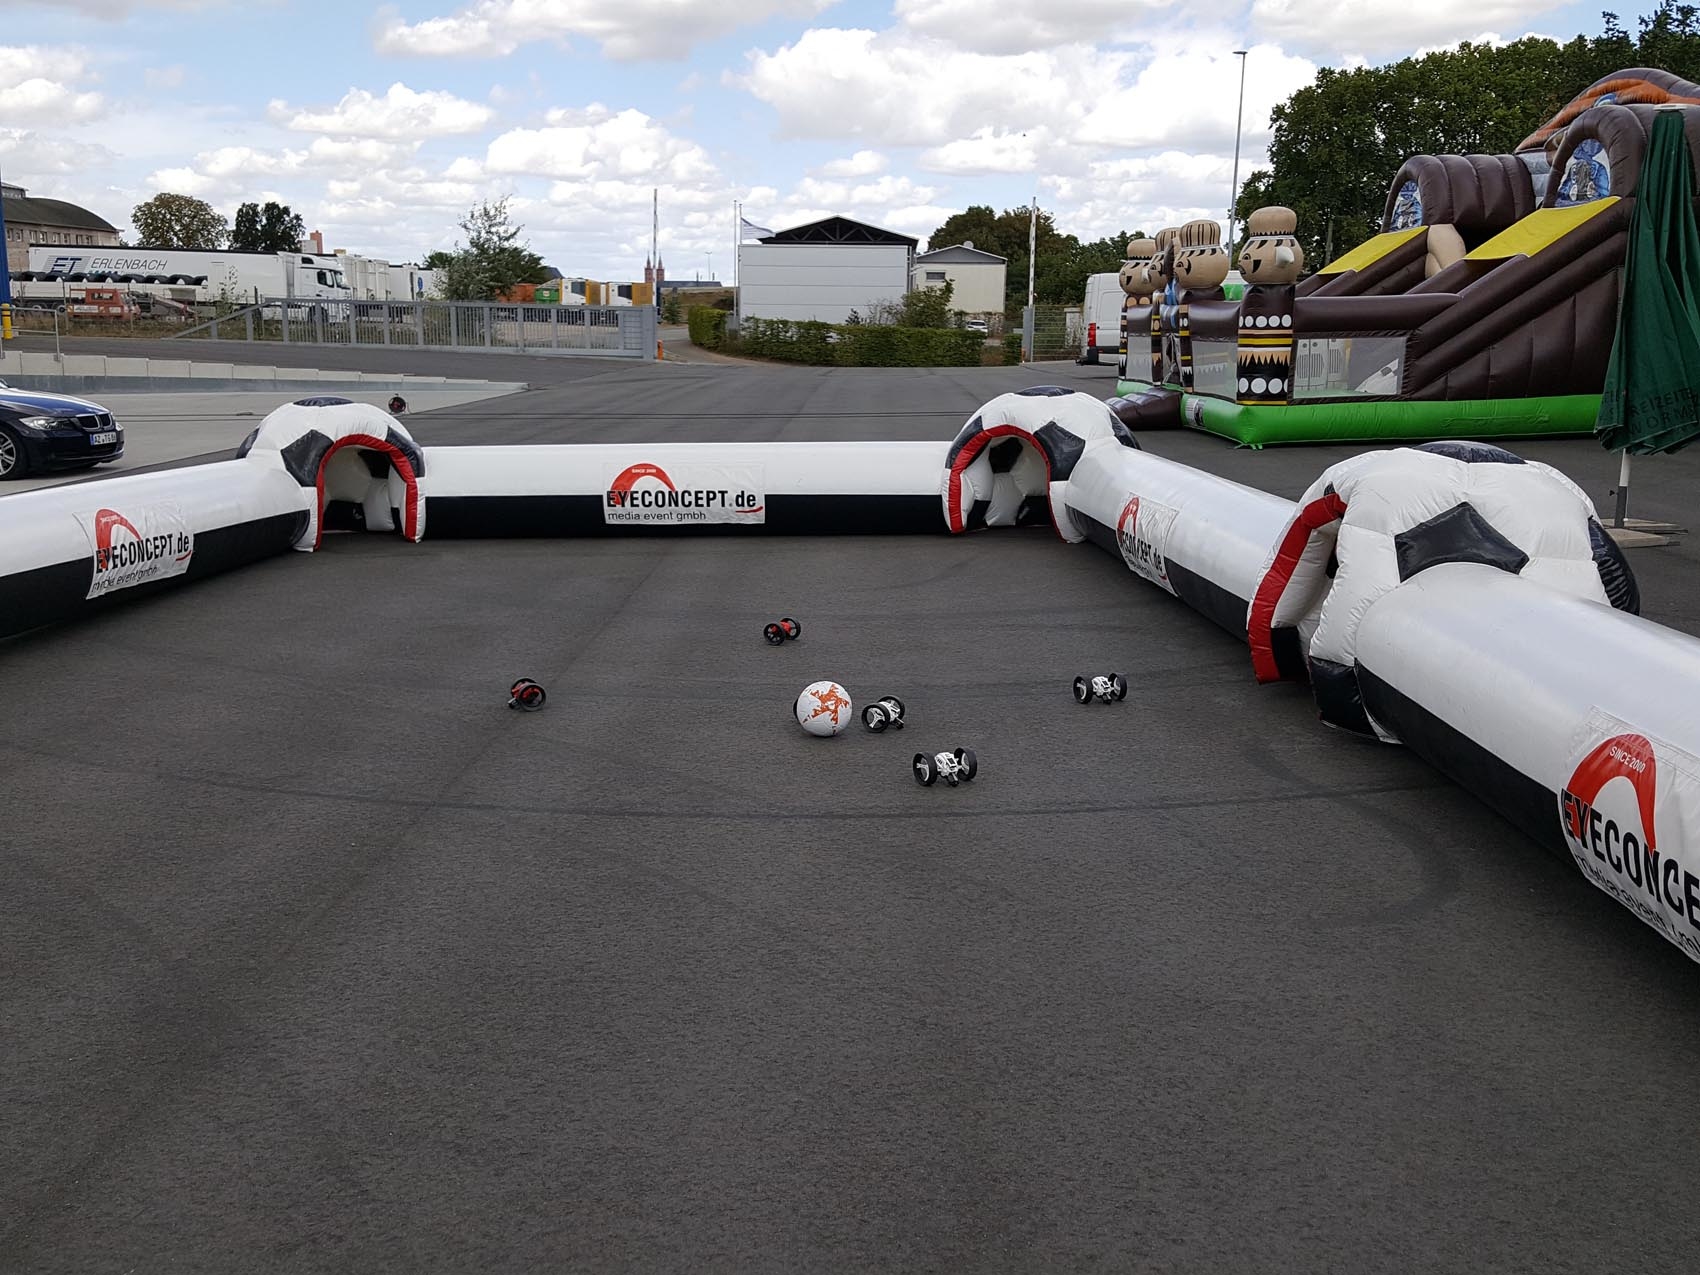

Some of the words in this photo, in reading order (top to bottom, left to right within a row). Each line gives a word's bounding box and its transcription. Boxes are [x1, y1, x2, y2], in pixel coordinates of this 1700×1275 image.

[50, 257, 82, 273] ET
[91, 258, 168, 270] ERLENBACH
[606, 490, 757, 508] EYECONCEPT.de
[607, 511, 641, 520] media
[643, 511, 675, 520] event
[676, 511, 707, 521] gmbh
[96, 532, 190, 574] EYECONCEPT.de
[1609, 746, 1631, 768] SINCE
[1630, 756, 1646, 774] 2000
